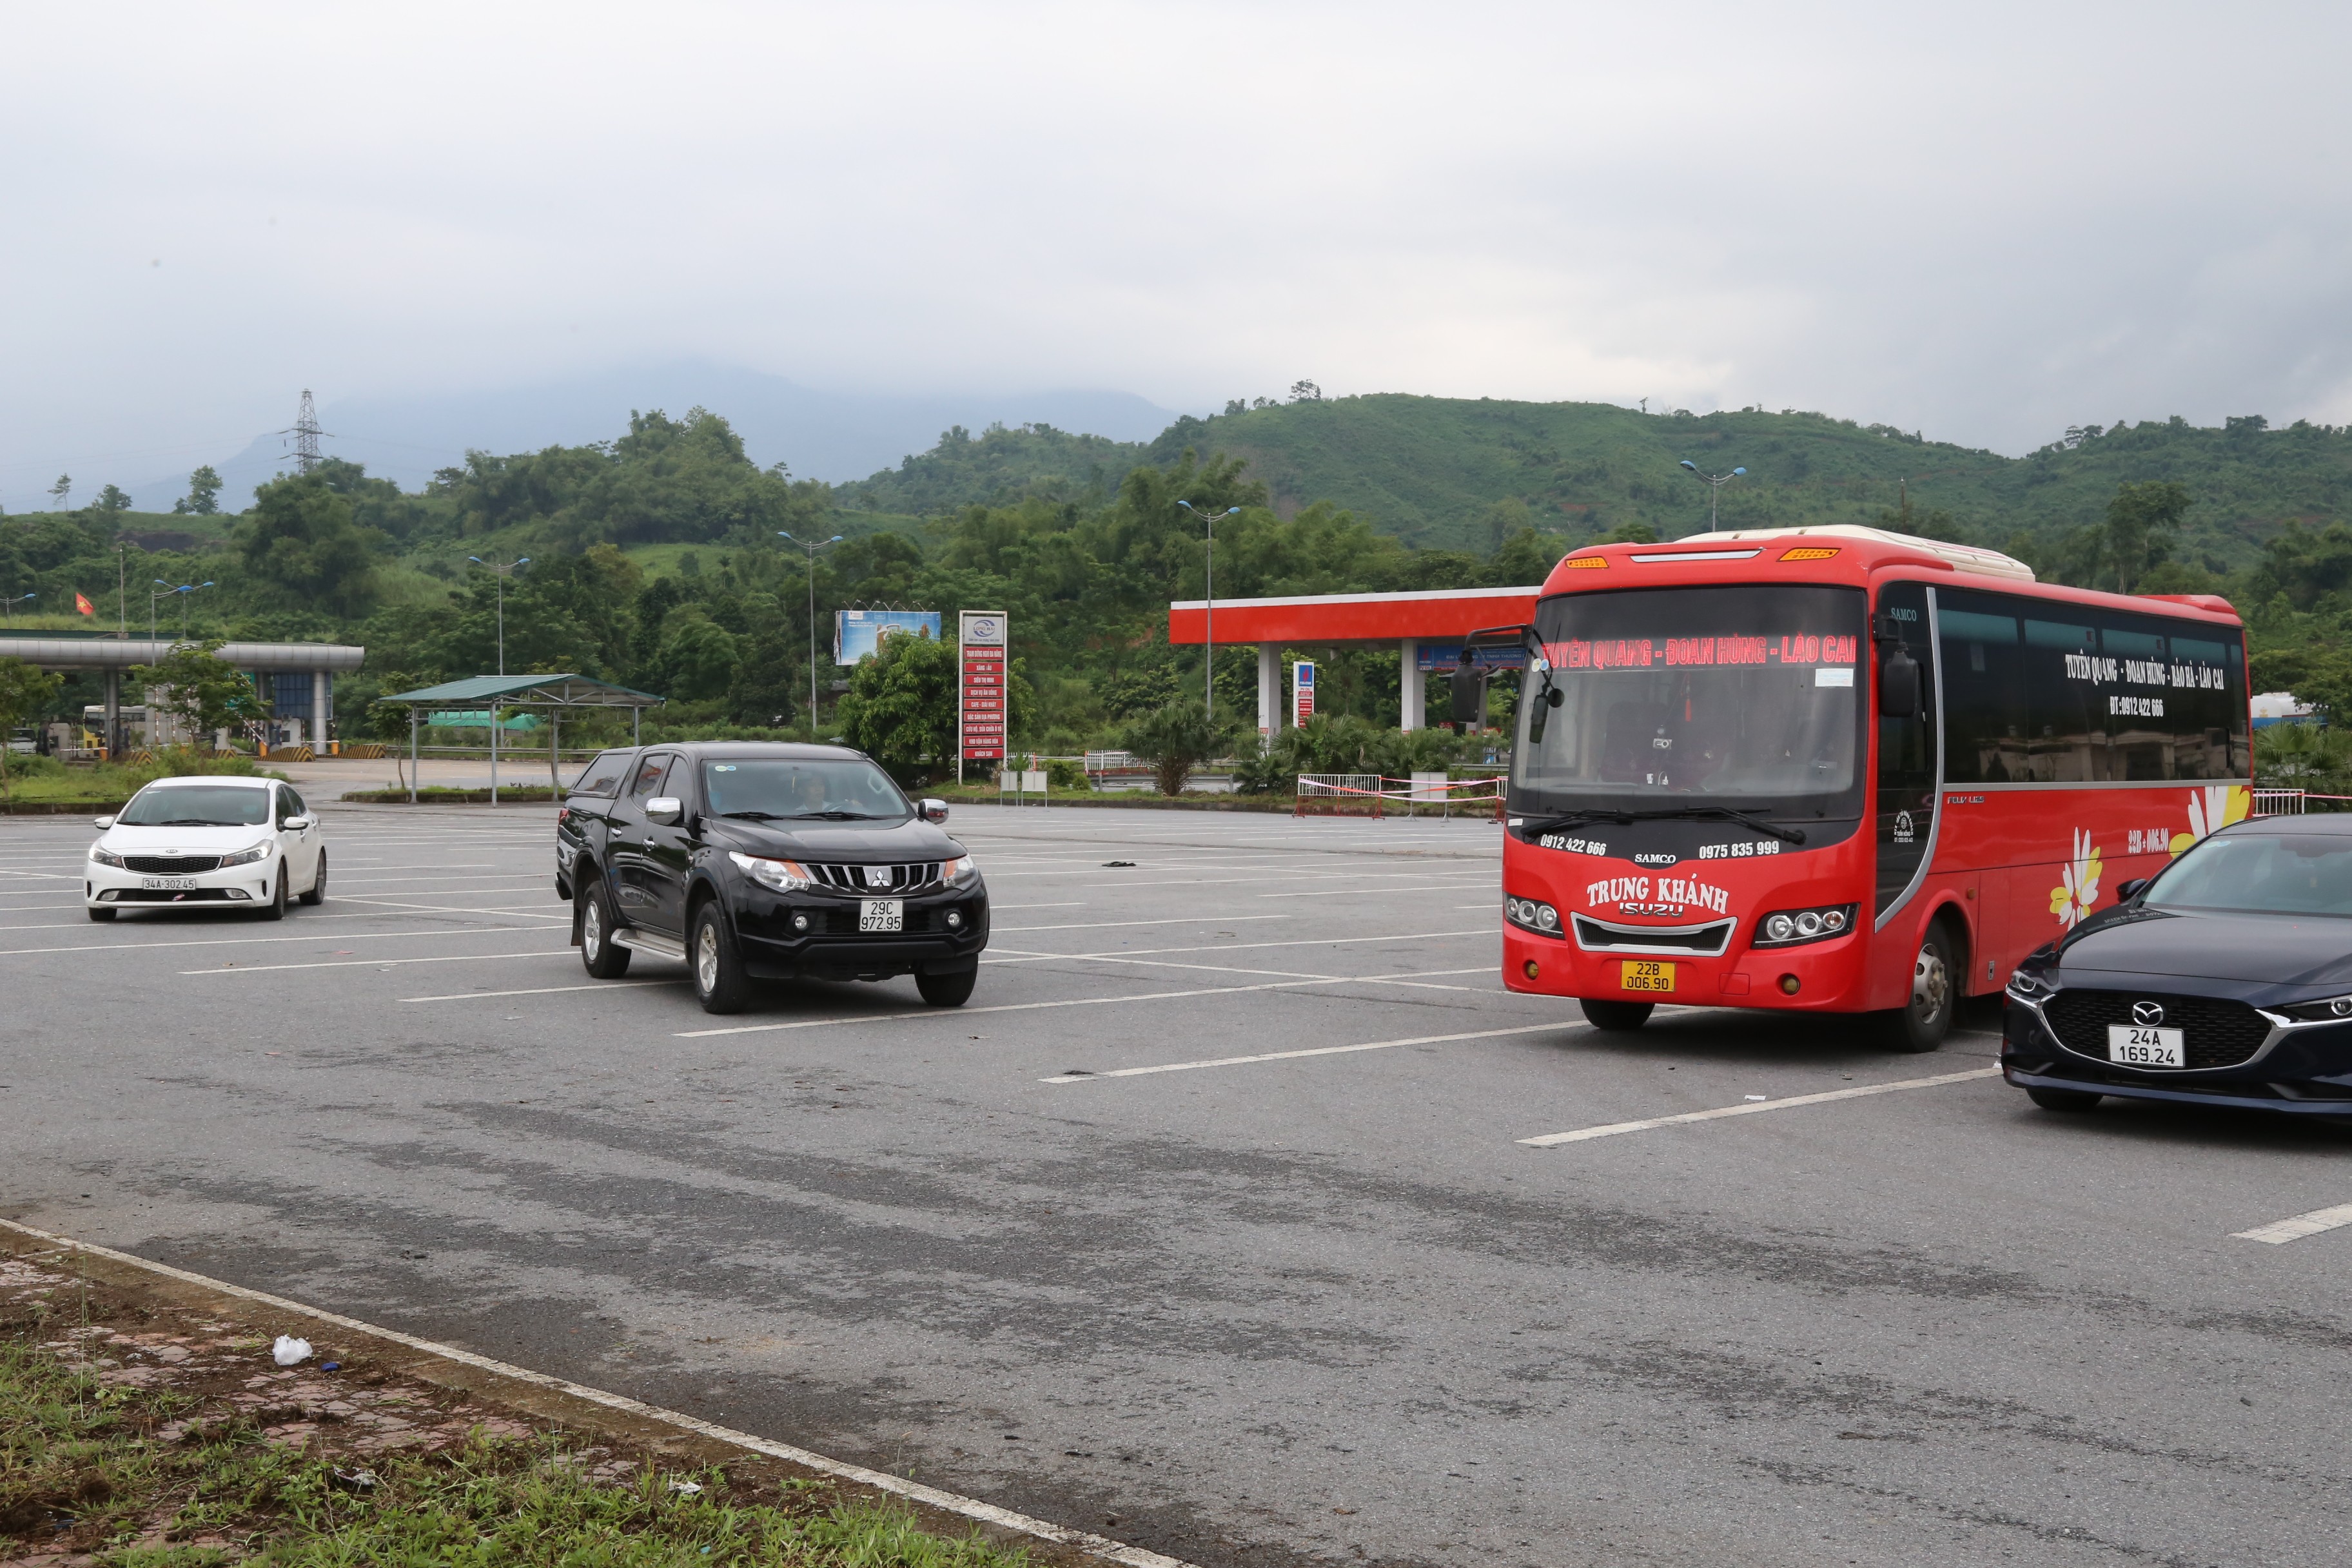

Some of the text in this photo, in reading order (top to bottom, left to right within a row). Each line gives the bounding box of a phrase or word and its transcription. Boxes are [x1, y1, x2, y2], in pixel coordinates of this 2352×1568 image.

[1891, 607, 1917, 622] SAMCO
[1592, 639, 1652, 669] QUANG
[1665, 638, 1714, 665] ĐOAN
[1822, 635, 1856, 663] CAI
[2065, 648, 2091, 680] TUYÊN
[2091, 656, 2118, 686] QUANG
[2125, 659, 2146, 684] ĐOAN
[2146, 656, 2166, 685] HÙNG
[2213, 668, 2224, 690] CAI
[2139, 698, 2151, 716] 422
[2151, 699, 2164, 717] 666
[1540, 834, 1607, 856] 0912 422 666
[1699, 840, 1779, 859] 0975 835 999
[1634, 854, 1676, 864] SAMCO
[144, 879, 194, 889] 34A-302.45
[1587, 872, 1729, 914] TRUNG KHÁNH
[871, 901, 893, 915] 29C
[1619, 903, 1683, 917] ISUZU
[861, 916, 901, 930] 972.95
[1636, 963, 1660, 975] 22B
[1627, 976, 1669, 990] 006.90
[2130, 1029, 2161, 1046] 24A
[2119, 1046, 2175, 1064] 169.24
